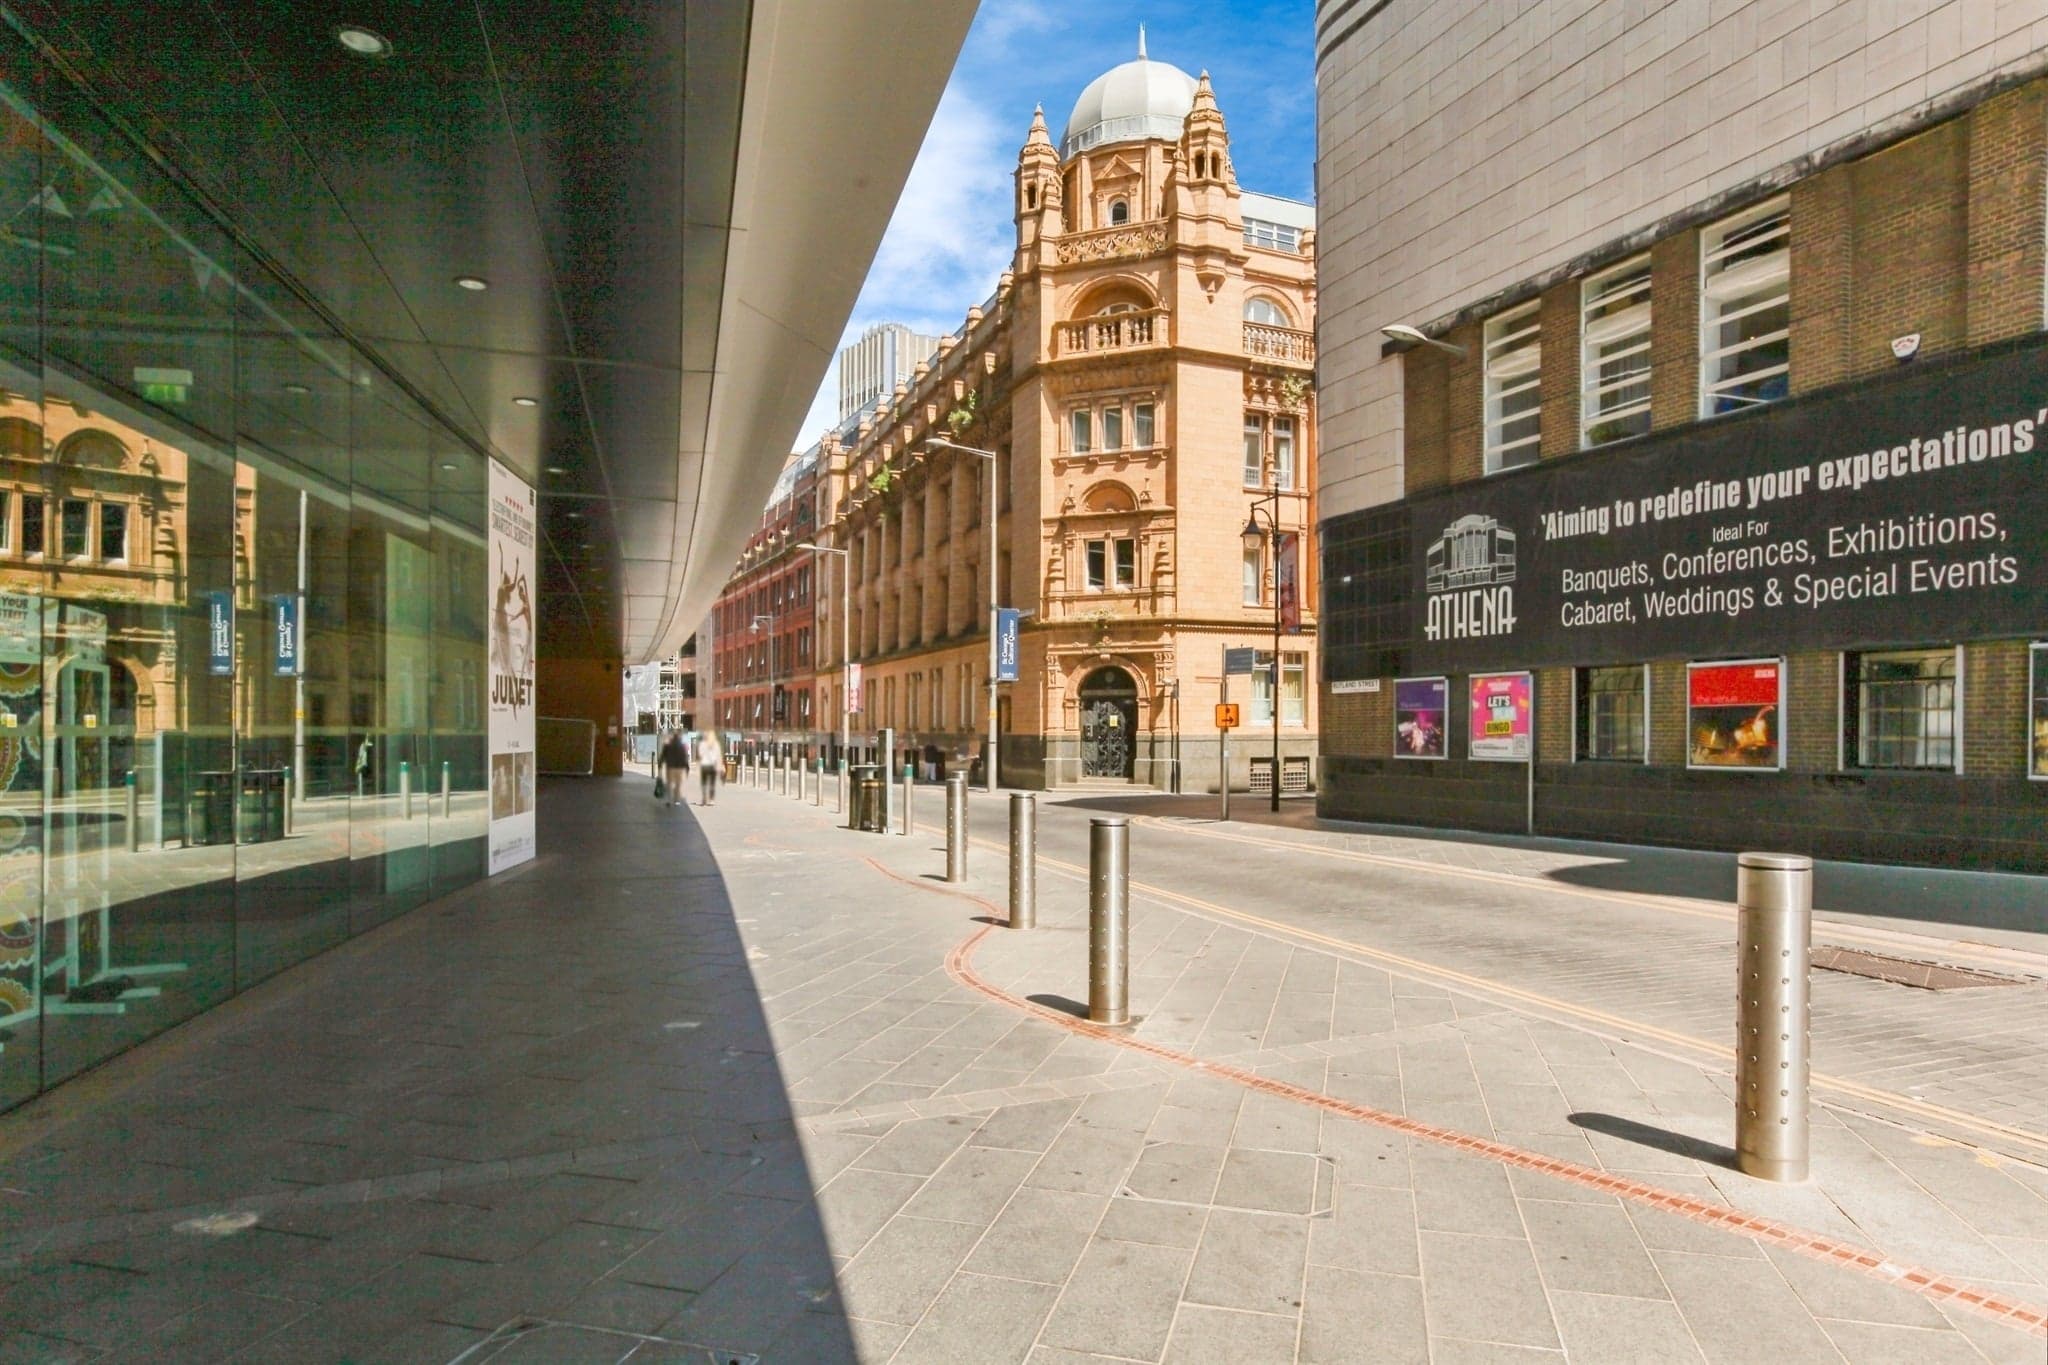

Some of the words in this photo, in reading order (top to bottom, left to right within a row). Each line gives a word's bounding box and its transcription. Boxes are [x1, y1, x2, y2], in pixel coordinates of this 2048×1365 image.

[1614, 499, 1635, 528] to
[1640, 480, 1741, 523] redefine
[1747, 465, 1811, 510] your
[1562, 560, 1654, 594] Banquets,
[1662, 539, 1816, 580] Conferences,
[1828, 512, 2007, 558] Exhibitions,
[1712, 523, 1743, 543] Ideal
[1747, 520, 1769, 537] For
[1424, 585, 1518, 641] ATHENA
[1561, 596, 1636, 627] Cabaret,
[1643, 585, 1754, 617] Weddings
[1763, 577, 1783, 607] &
[1793, 563, 1897, 609] Special
[1910, 552, 2018, 593] Events
[1357, 680, 1379, 688] STREET
[1487, 695, 1511, 708] LET'S
